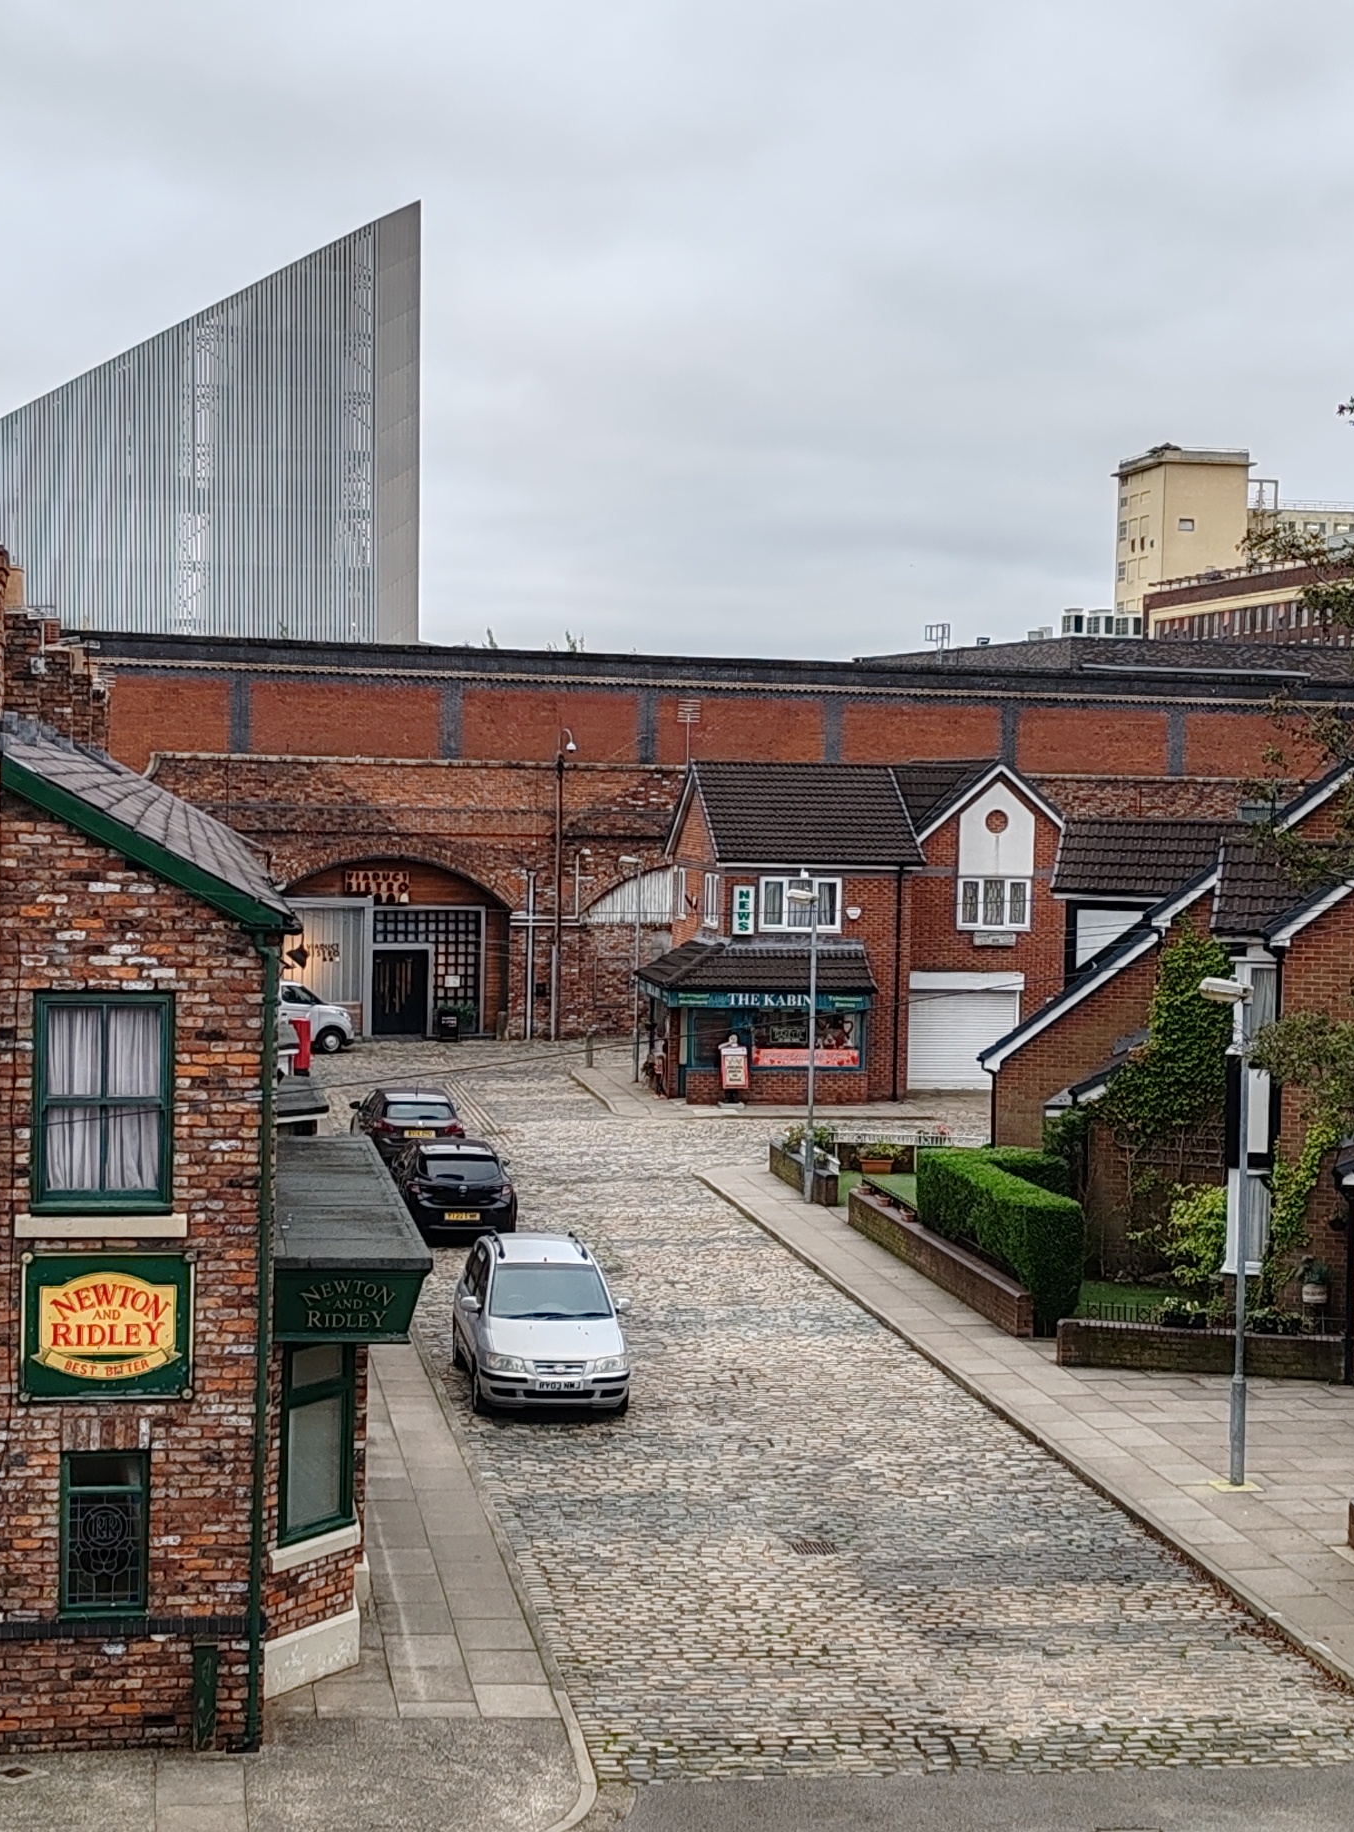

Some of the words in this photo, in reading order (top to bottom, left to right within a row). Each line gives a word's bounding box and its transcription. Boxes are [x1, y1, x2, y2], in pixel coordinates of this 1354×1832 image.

[347, 872, 408, 882] VIADUCT
[347, 882, 409, 892] BISTRO
[737, 889, 750, 931] NEWS
[727, 993, 760, 1006] THE
[763, 993, 812, 1007] KABIN
[50, 1283, 171, 1322] NEWTON
[299, 1280, 396, 1307] NEWTON
[332, 1299, 363, 1310] AND
[92, 1309, 121, 1321] AND
[306, 1310, 388, 1328] RIDLEY
[50, 1321, 166, 1347] RIDLEY
[64, 1360, 97, 1376] BEST
[104, 1359, 150, 1377] BITTER
